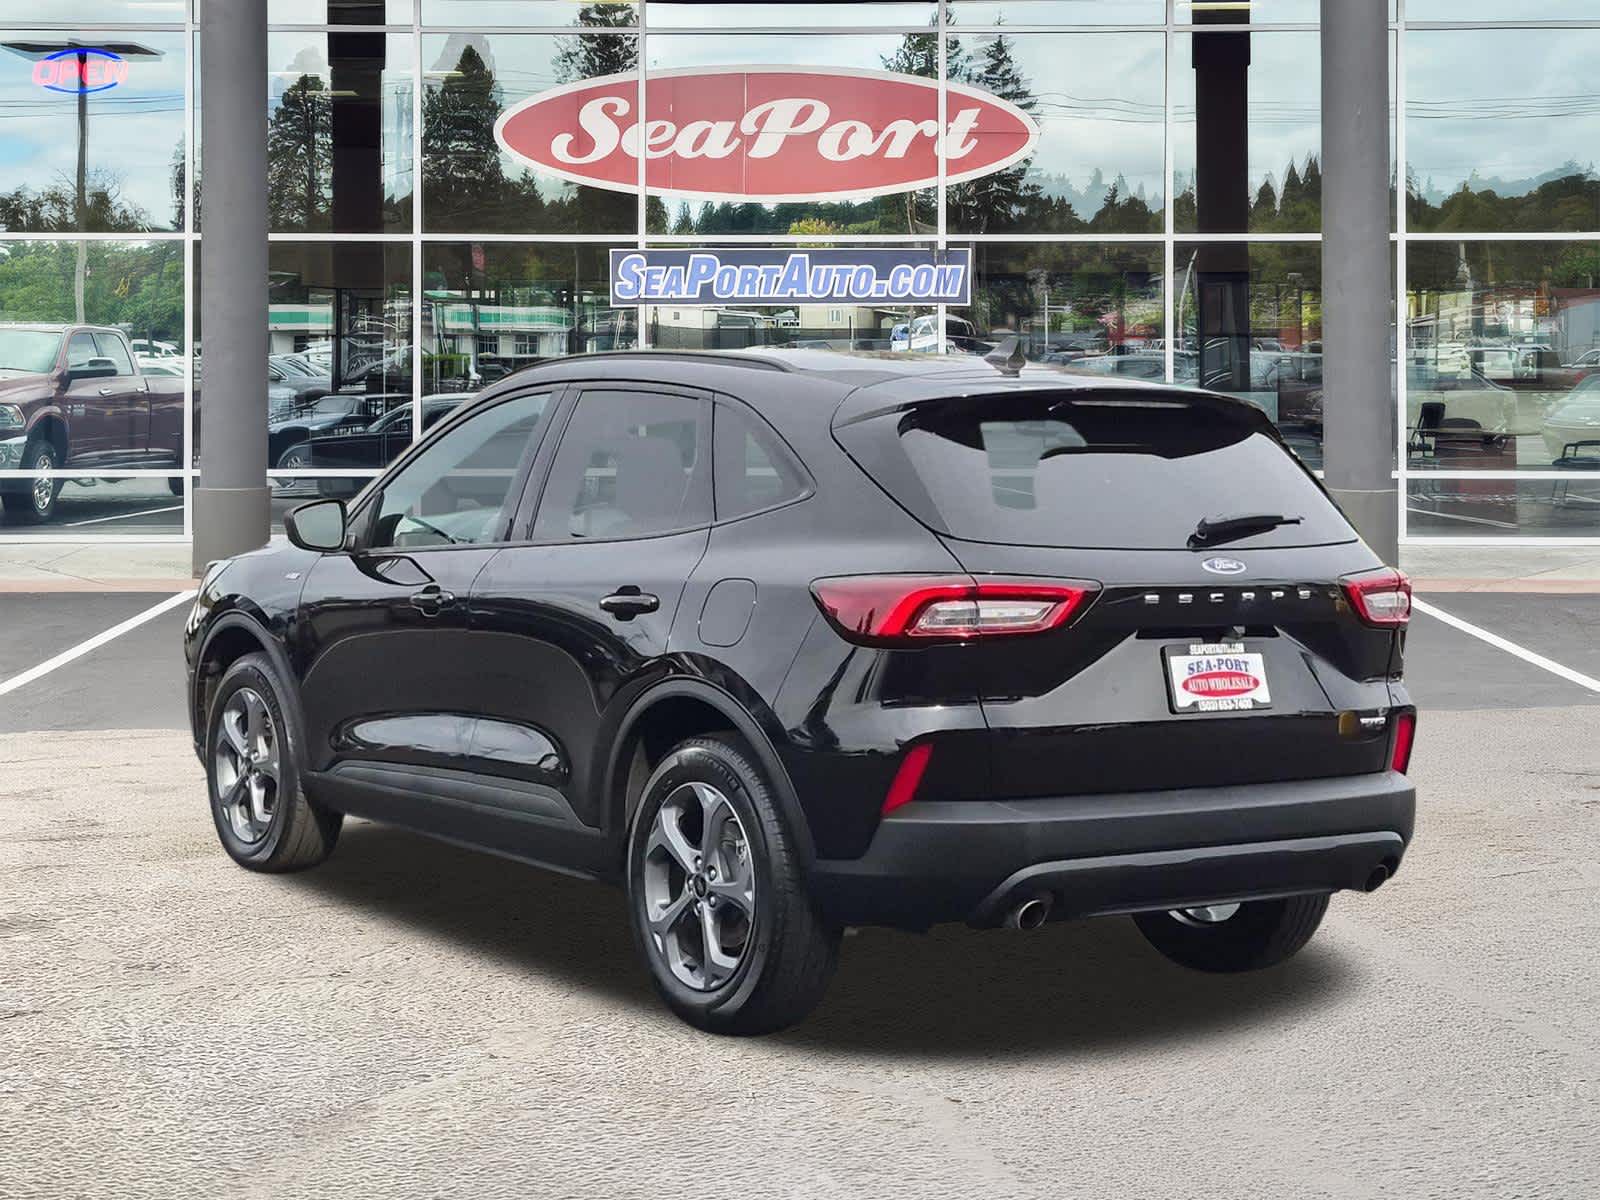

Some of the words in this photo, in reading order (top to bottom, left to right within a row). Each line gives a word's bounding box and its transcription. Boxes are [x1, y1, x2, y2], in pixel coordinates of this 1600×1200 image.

[32, 59, 128, 86] OPEN
[550, 96, 981, 164] SeaPort
[1188, 678, 1208, 692] AUTO
[1208, 676, 1253, 691] WHOLESALE
